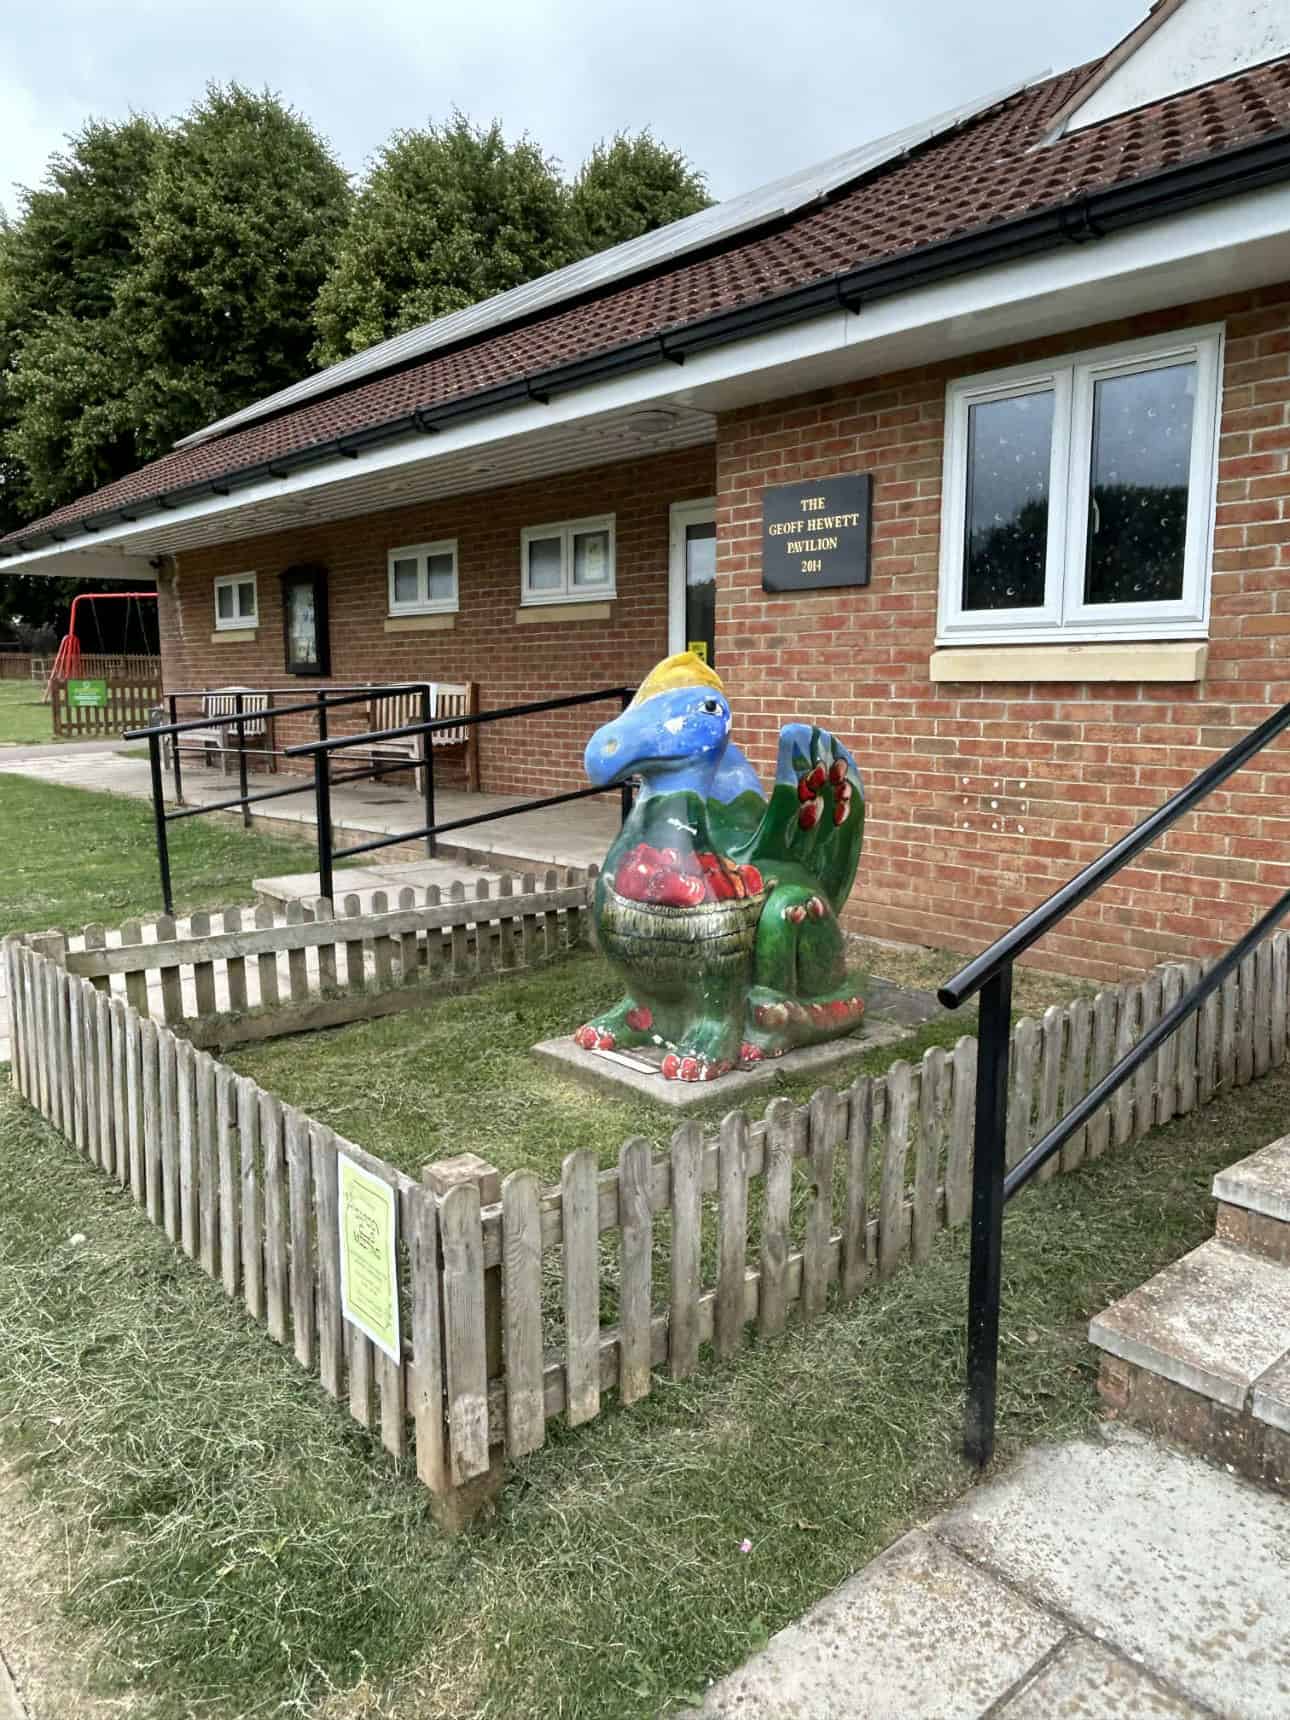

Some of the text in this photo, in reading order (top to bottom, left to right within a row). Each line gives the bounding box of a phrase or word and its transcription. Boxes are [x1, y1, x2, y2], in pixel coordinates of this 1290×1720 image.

[800, 496, 825, 511] THE
[768, 513, 860, 536] GEOFF HEWETT
[786, 537, 838, 554] PAVILION
[801, 559, 822, 573] 2014
